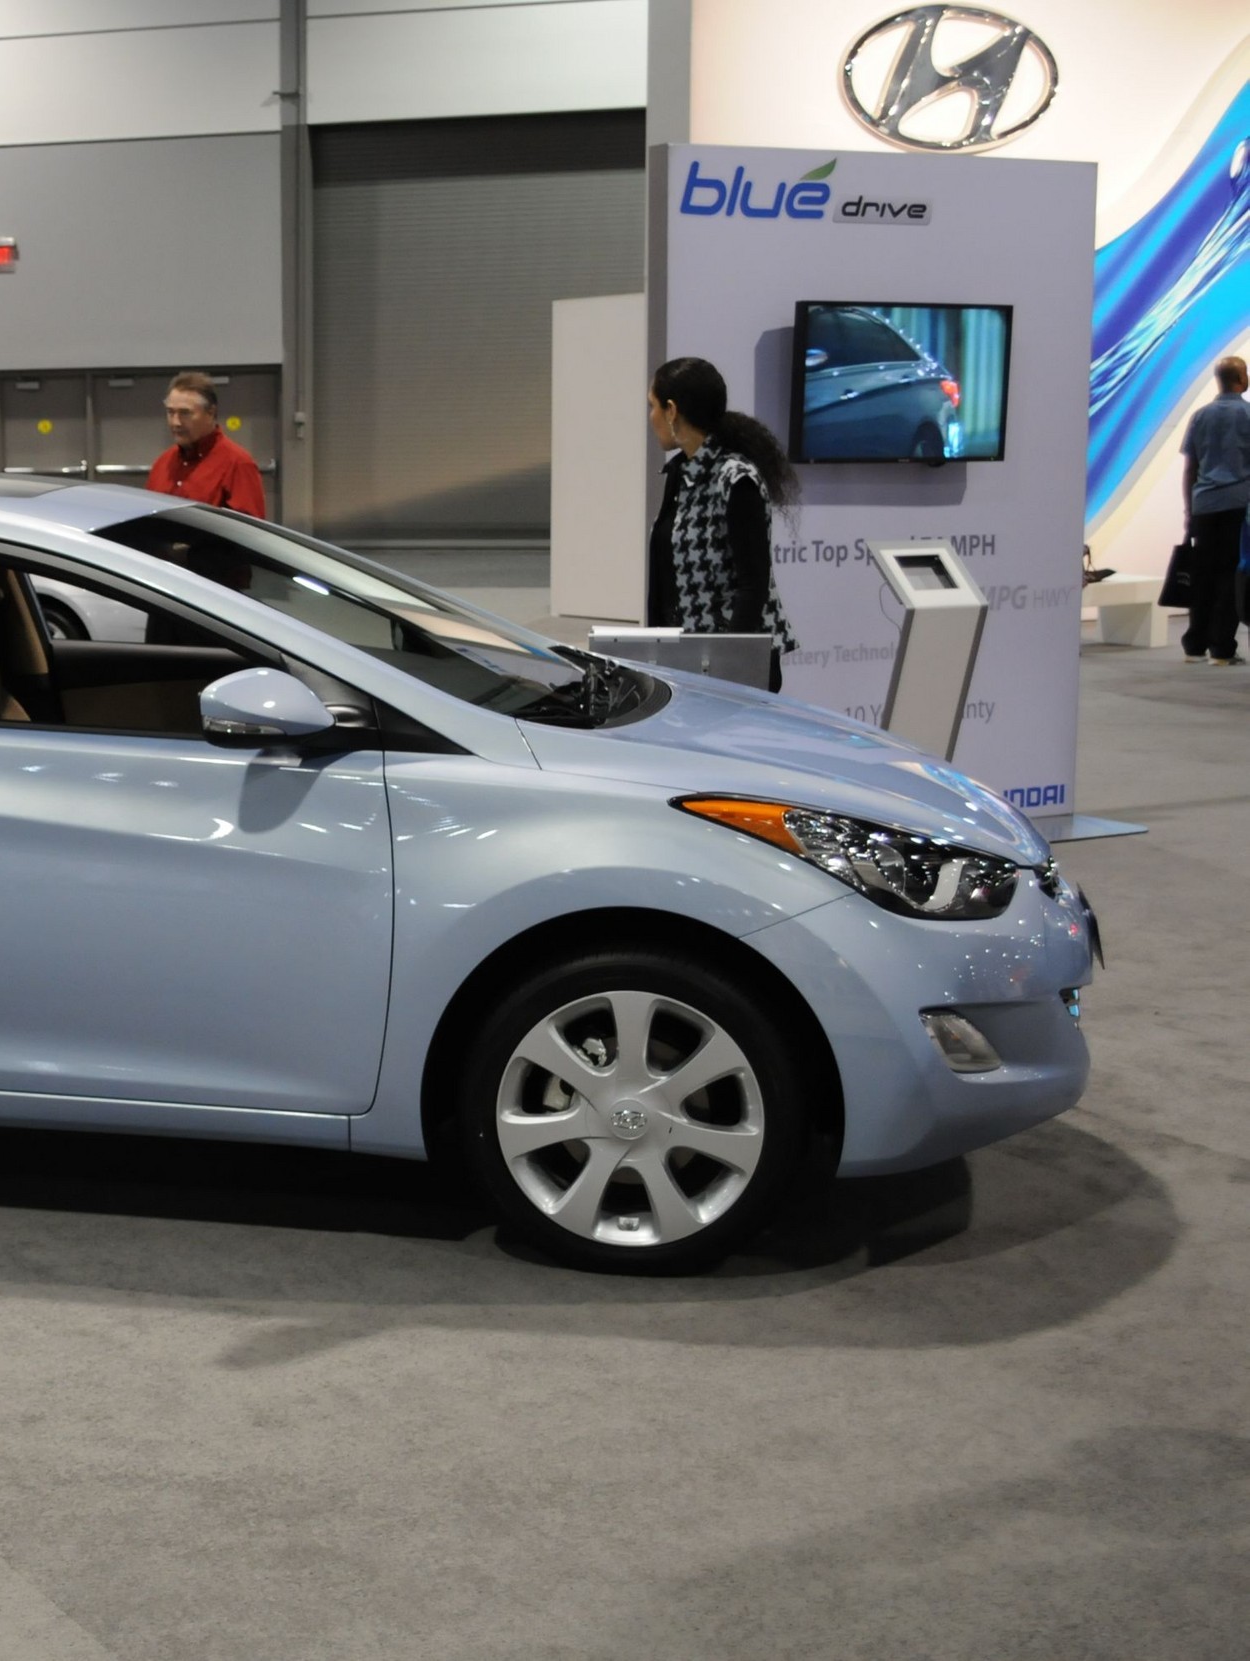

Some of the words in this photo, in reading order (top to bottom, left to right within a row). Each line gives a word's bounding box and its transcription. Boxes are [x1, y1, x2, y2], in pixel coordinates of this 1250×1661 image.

[679, 160, 831, 219] blue
[841, 195, 927, 219] drive
[773, 540, 807, 564] tric
[812, 539, 848, 567] Top
[951, 534, 996, 557] MPH
[1032, 587, 1071, 609] HWY
[781, 647, 830, 668] attery
[833, 642, 895, 664] Technol
[1003, 784, 1066, 809] NDAI
